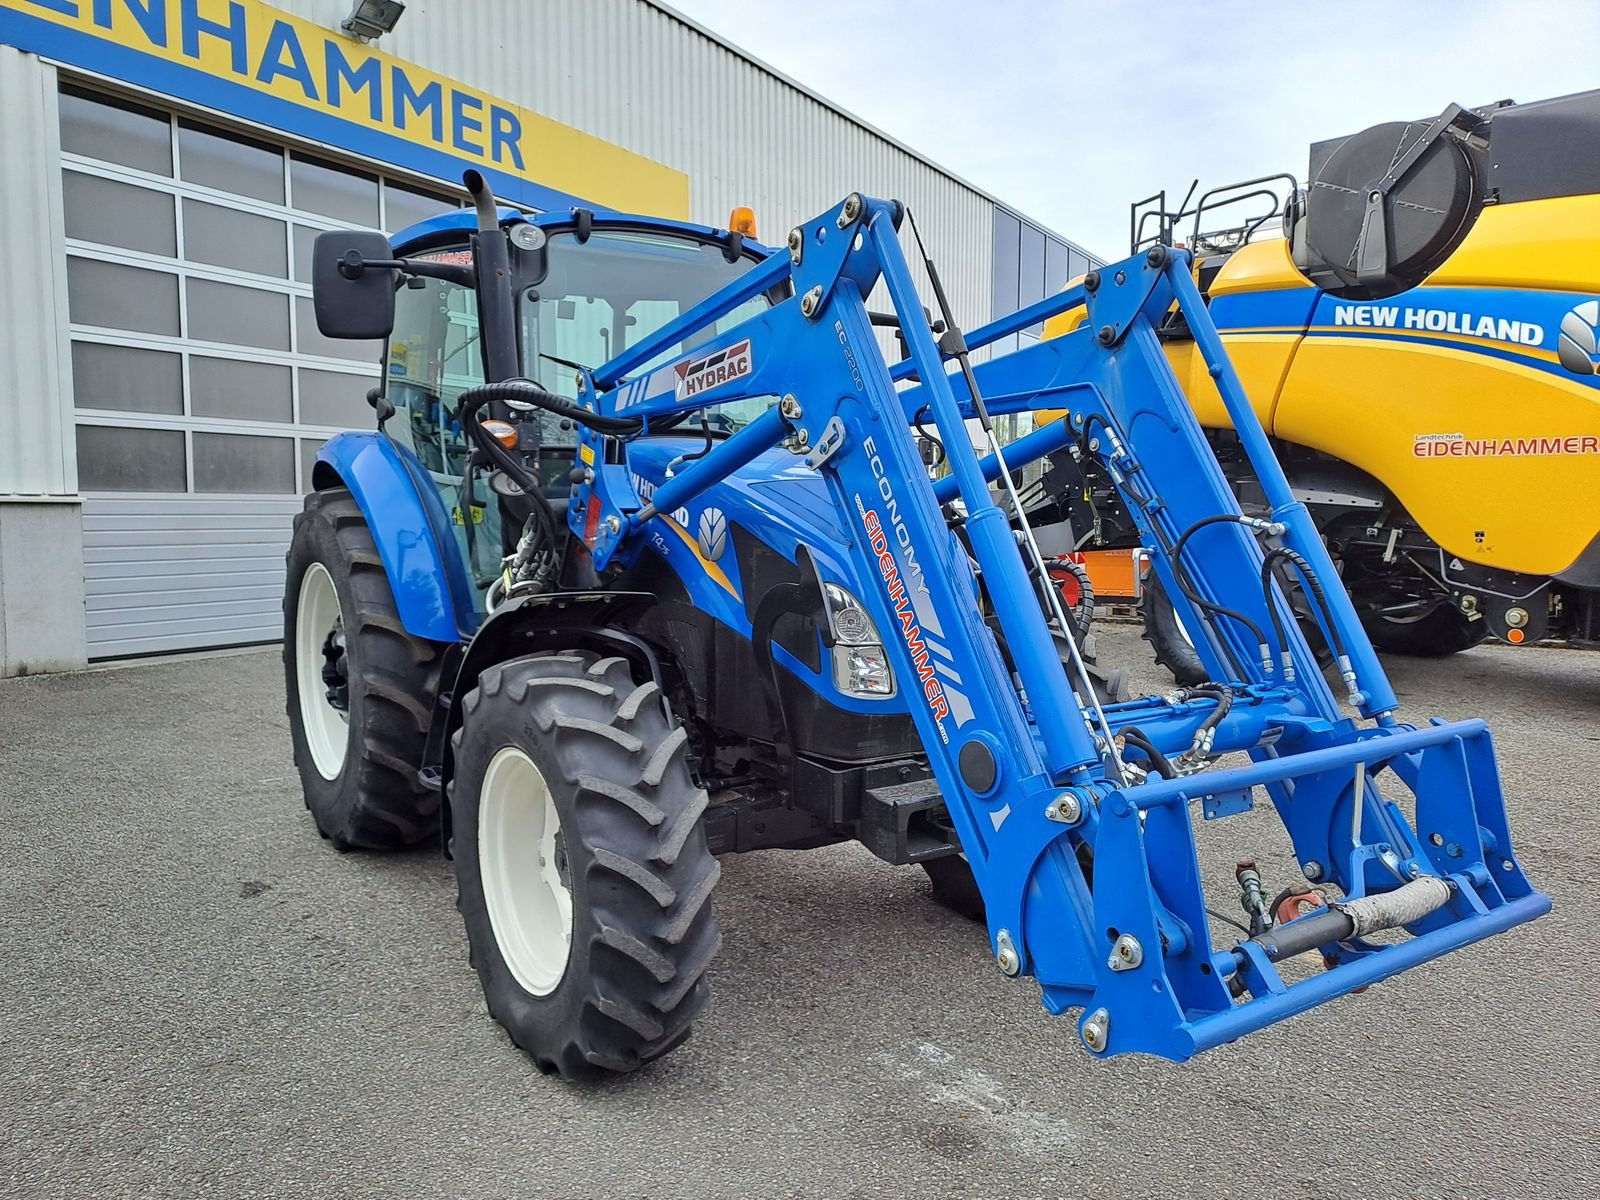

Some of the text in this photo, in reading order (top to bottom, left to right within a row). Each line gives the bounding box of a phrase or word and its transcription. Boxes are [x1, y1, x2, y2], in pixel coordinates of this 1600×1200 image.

[24, 0, 526, 171] NHAMMER
[1335, 305, 1544, 346] NEW HOLLAND
[686, 356, 748, 396] HYDRAC
[834, 319, 864, 392] EC 2200
[1413, 436, 1598, 457] EIDENHAMMER
[1414, 433, 1463, 441] Landtechnik
[863, 435, 930, 594] ECONOMY
